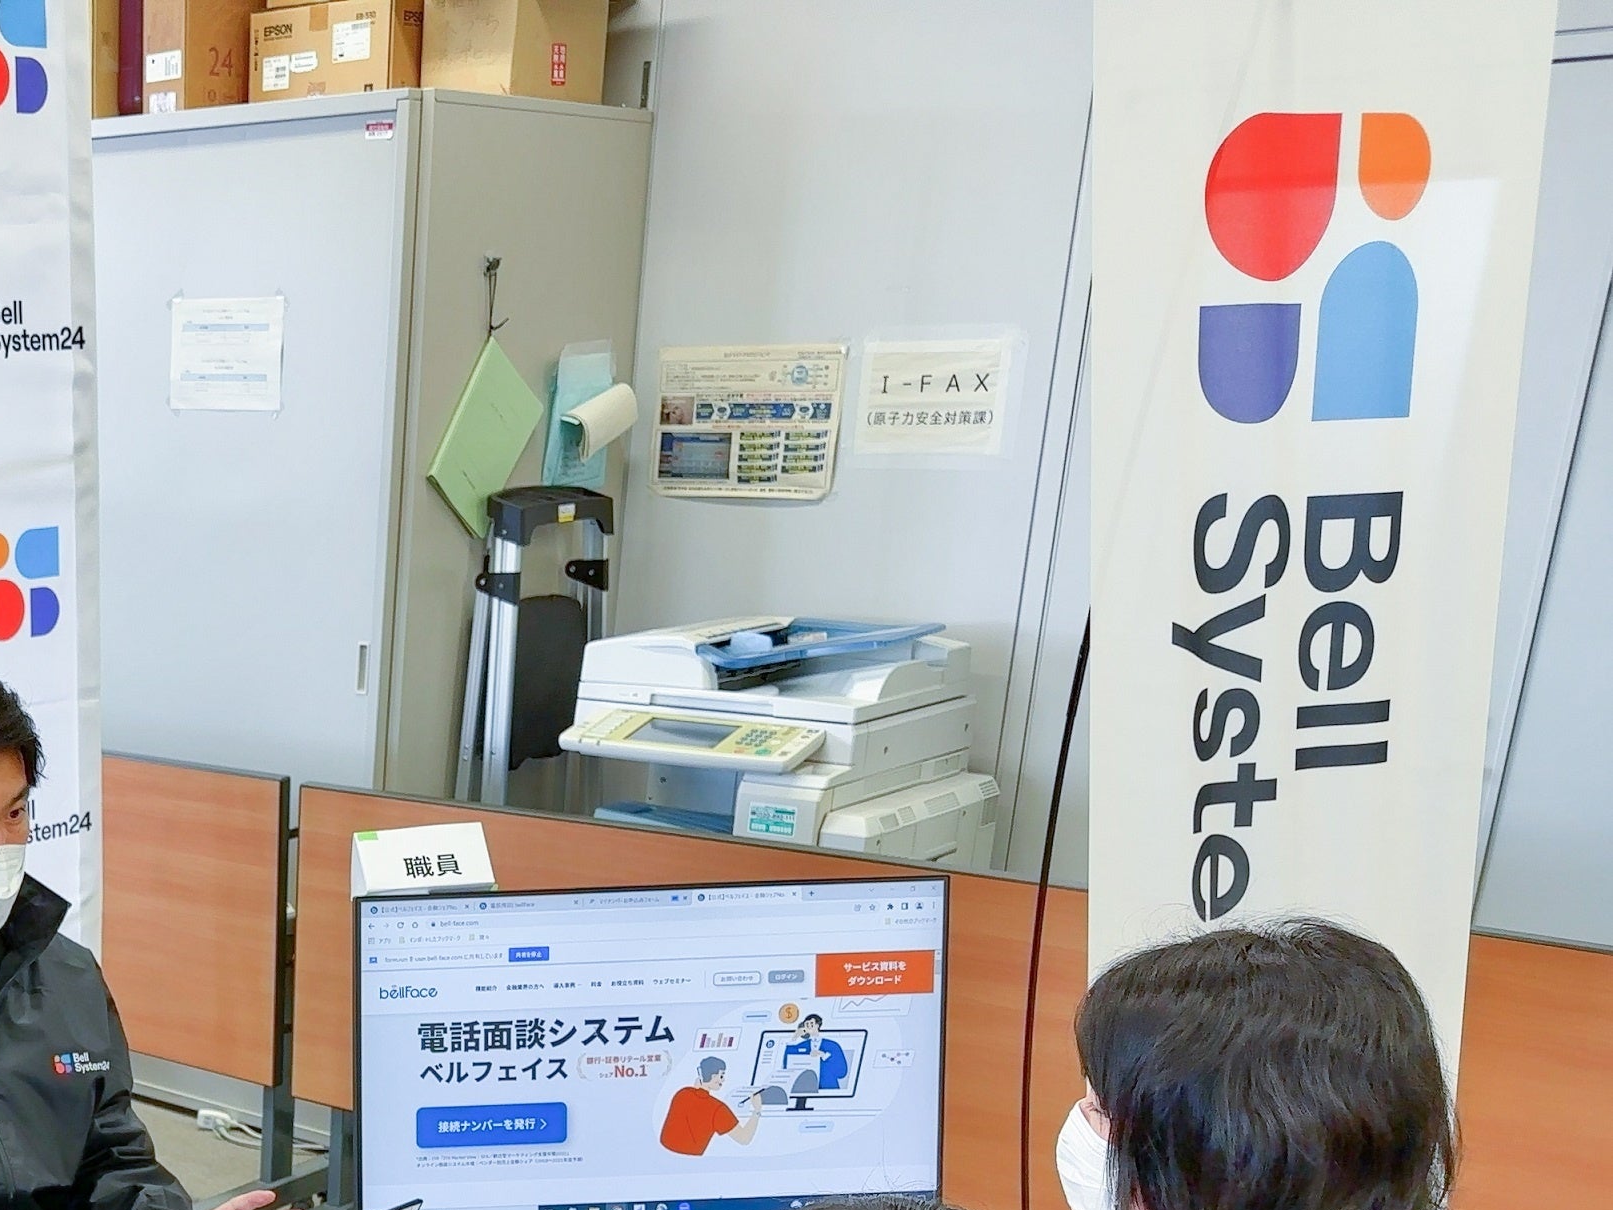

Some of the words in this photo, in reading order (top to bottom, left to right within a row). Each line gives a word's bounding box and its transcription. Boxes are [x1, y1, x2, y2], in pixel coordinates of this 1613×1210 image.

[264, 24, 292, 37] EPSON
[1294, 491, 1405, 771] Bell
[1171, 492, 1292, 923] Syste
[27, 811, 92, 844] stem24
[403, 853, 463, 880] 職員
[843, 961, 907, 973] サービス資料を
[847, 974, 903, 987] ダウンロード
[417, 1014, 675, 1053] 電話面談システム
[72, 1052, 90, 1062] Bell
[74, 1061, 110, 1074] System24
[420, 1056, 568, 1084] ベルフェイス
[438, 1118, 536, 1134] 接続ナンバーを発行
